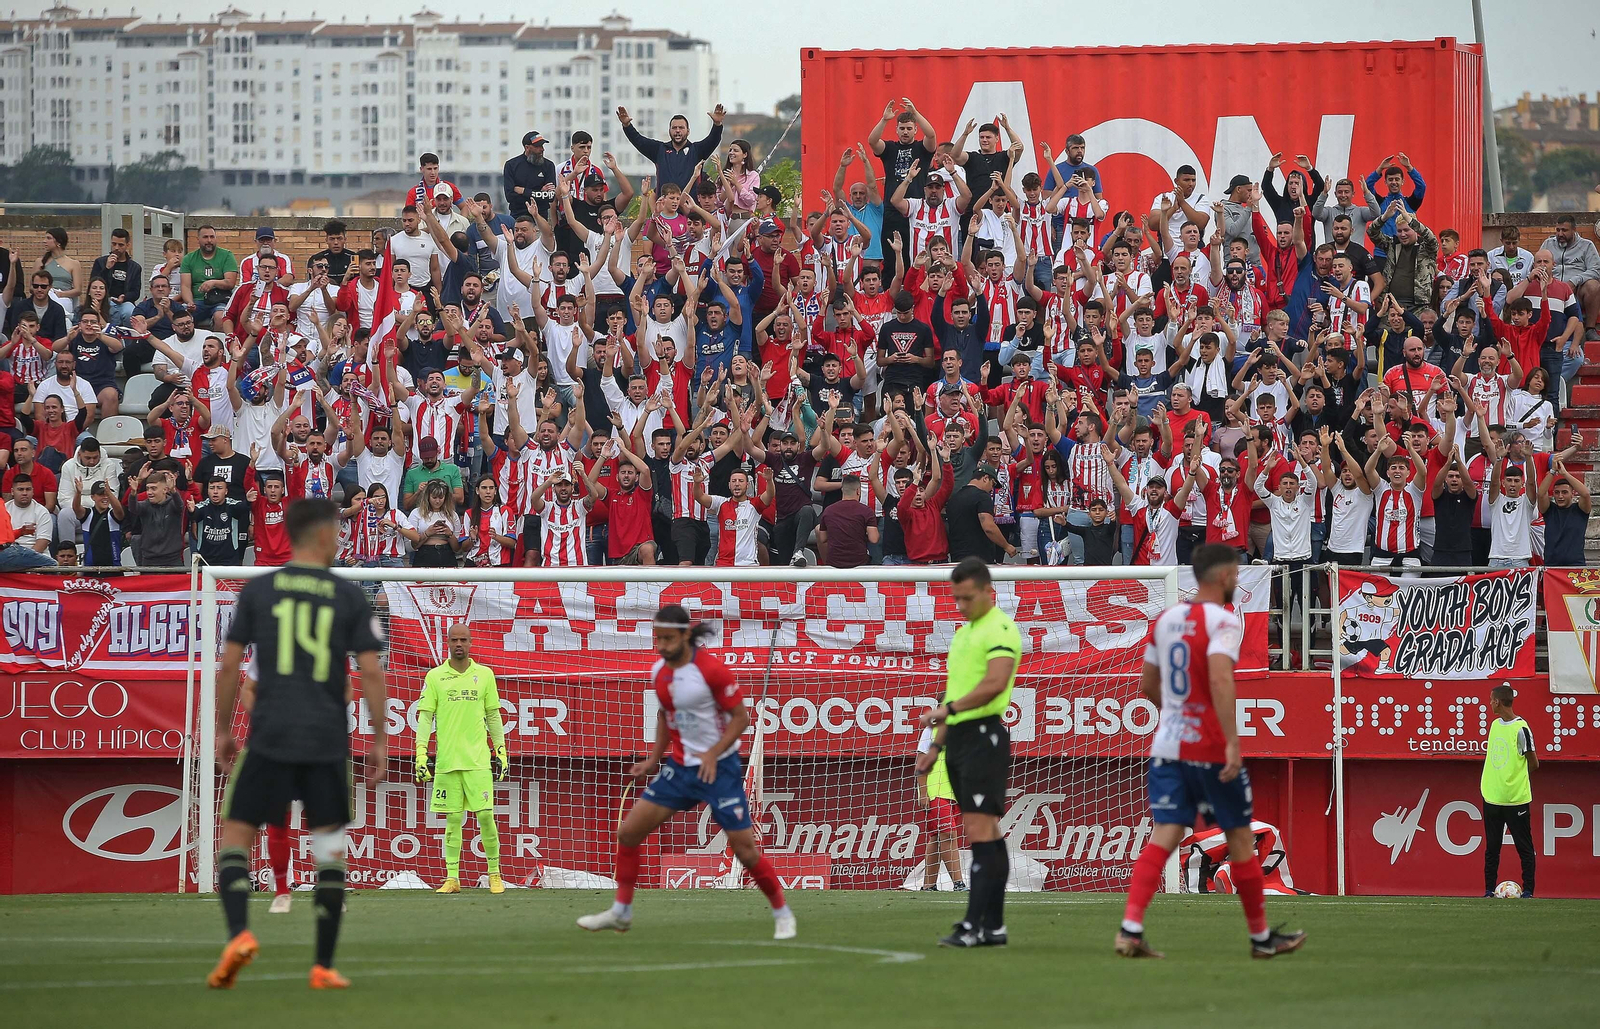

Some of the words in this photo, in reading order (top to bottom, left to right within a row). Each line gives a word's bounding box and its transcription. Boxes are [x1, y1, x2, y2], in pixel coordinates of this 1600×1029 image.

[204, 525, 230, 535] Emirates
[1396, 583, 1470, 637] YOUTH
[1471, 571, 1534, 628] BOYS
[3, 601, 61, 654] SOY
[1358, 612, 1382, 625] 1909
[272, 598, 334, 682] 14
[1393, 628, 1478, 676] GRADA
[1477, 619, 1531, 672] ACF
[772, 651, 818, 664] ACF
[832, 654, 913, 668] FONDO
[1170, 642, 1188, 695] 8
[1045, 698, 1286, 737] BESOER
[20, 729, 86, 750] CLUB
[98, 725, 184, 750] HÍPICO
[435, 789, 447, 801] 24
[872, 865, 886, 876] en
[1101, 865, 1133, 880] integr
